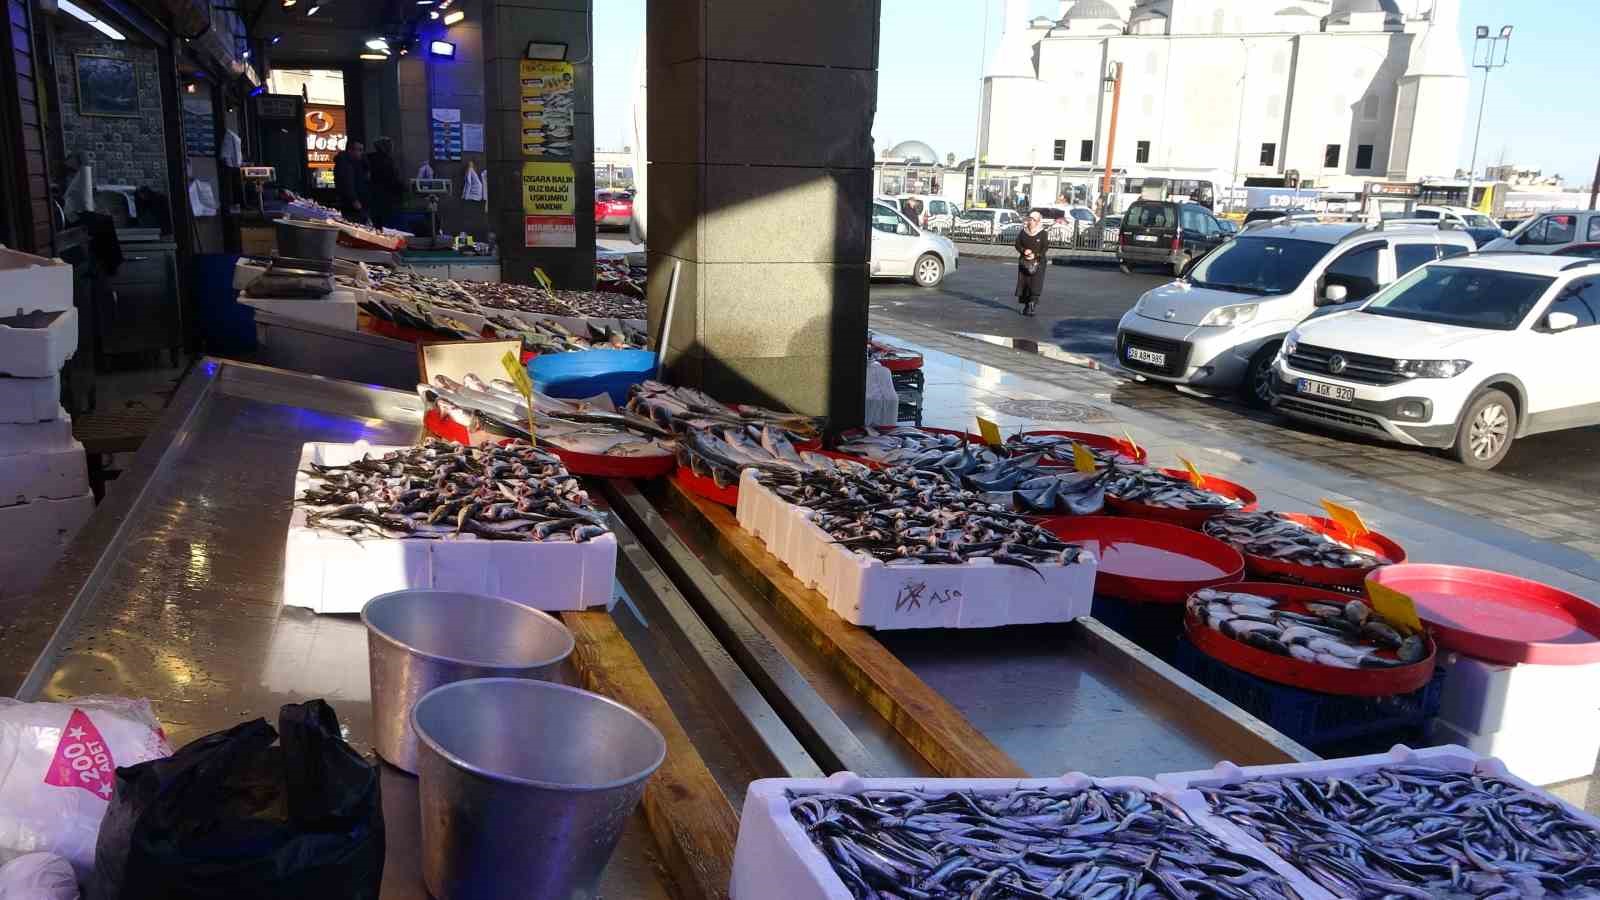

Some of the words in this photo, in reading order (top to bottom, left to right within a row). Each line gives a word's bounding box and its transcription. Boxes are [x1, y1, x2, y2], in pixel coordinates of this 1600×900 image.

[528, 185, 544, 193] BUZ
[530, 194, 568, 202] USKUMRU
[1336, 387, 1352, 400] 920
[63, 743, 100, 783] 200
[86, 740, 111, 773] ADET
